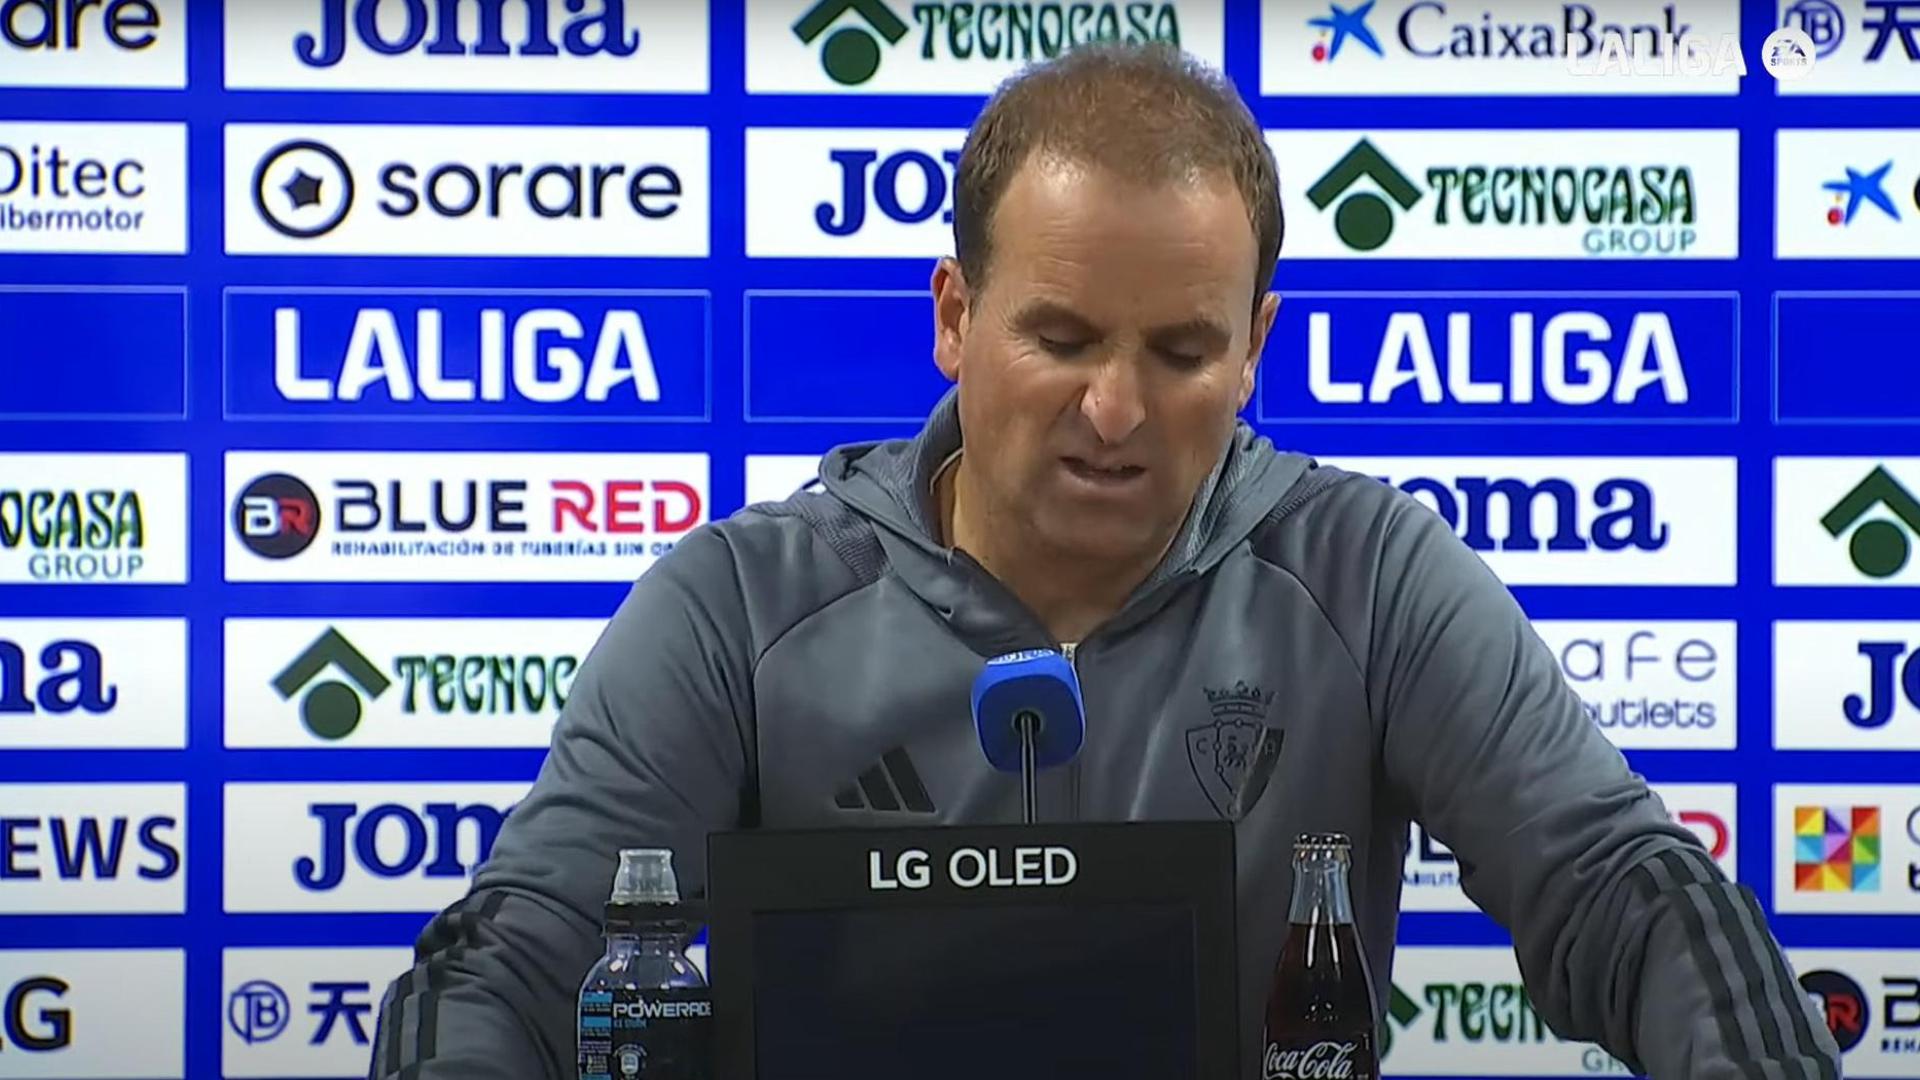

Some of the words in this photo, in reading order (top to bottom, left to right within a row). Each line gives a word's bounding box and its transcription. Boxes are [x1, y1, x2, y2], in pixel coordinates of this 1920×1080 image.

[913, 3, 1180, 59] TECNOCASA
[378, 163, 682, 218] sorare
[1426, 166, 1697, 225] TECNOCASA
[1582, 229, 1697, 253] GROUP
[275, 308, 660, 401] LALIGA
[1308, 312, 1690, 404] LALIGA
[332, 480, 528, 533] BLUE
[549, 480, 702, 534] RED
[28, 553, 144, 578] GROUP
[331, 538, 486, 556] REHABILITACIÓN
[870, 850, 931, 888] LG
[949, 847, 1077, 887] OLED
[0, 975, 71, 1052] G
[308, 982, 372, 1045] 天
[612, 999, 712, 1018] POWERADE
[1264, 1040, 1358, 1080] Coca-Cola
